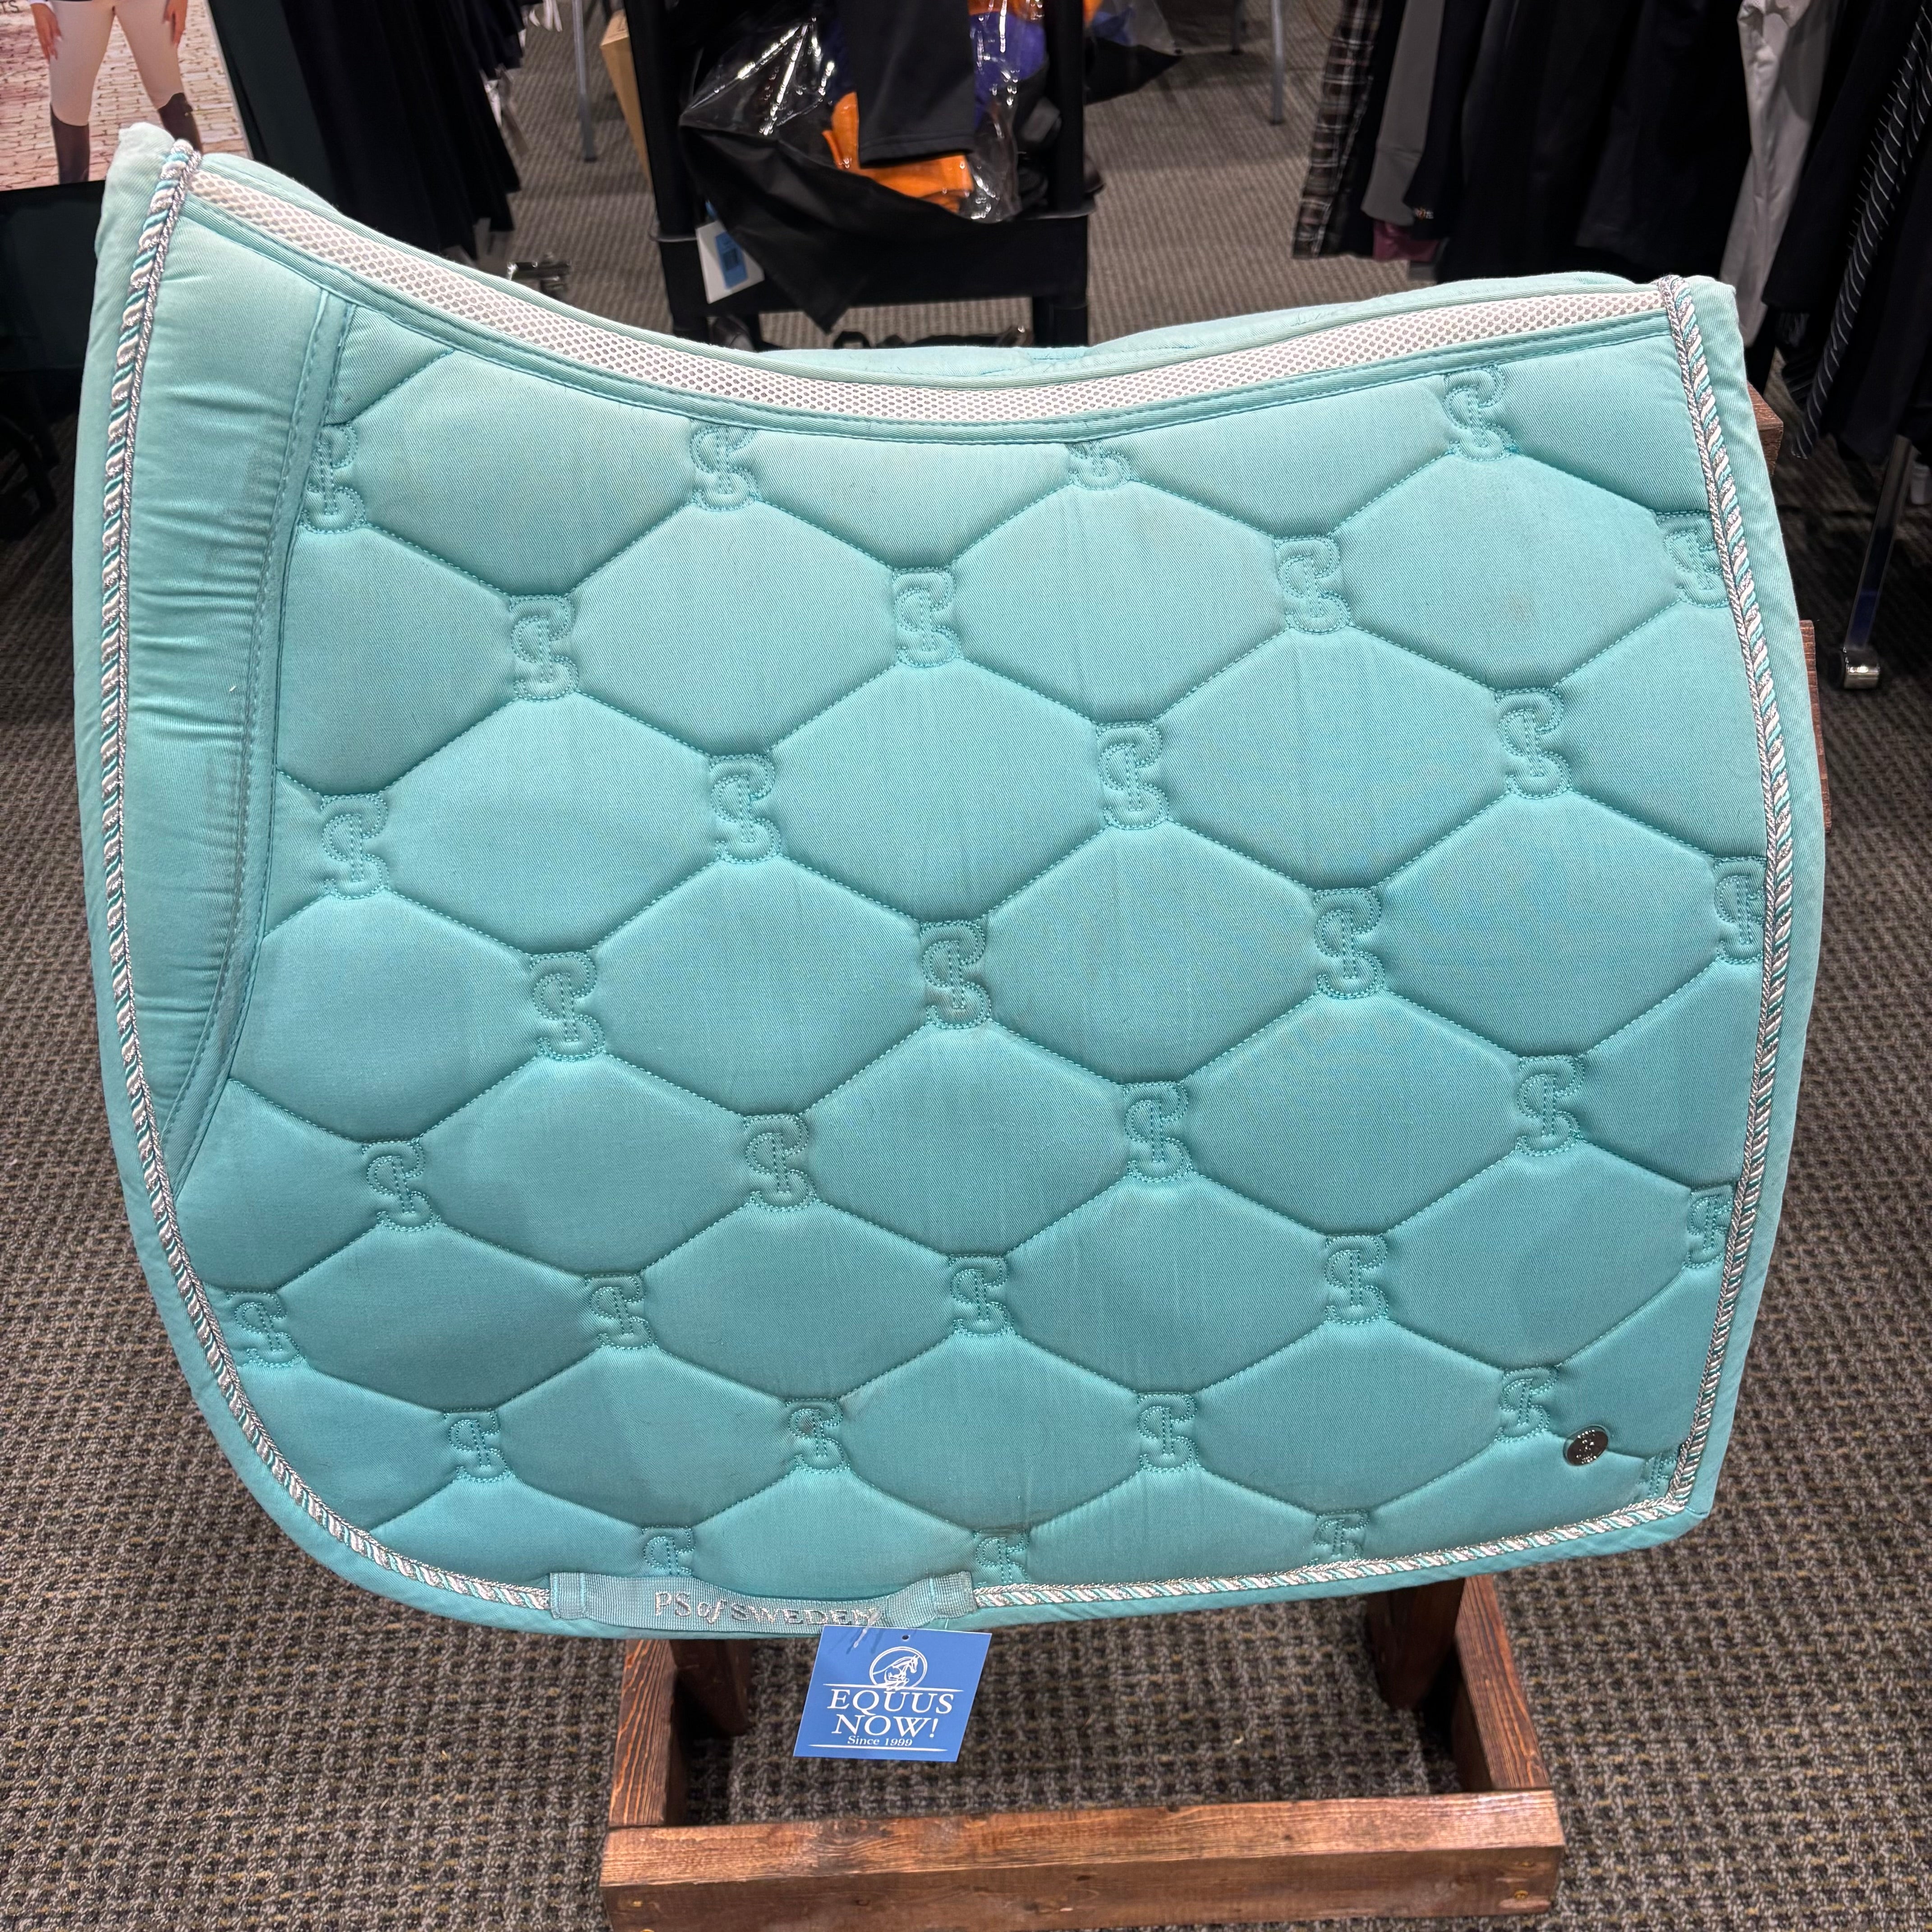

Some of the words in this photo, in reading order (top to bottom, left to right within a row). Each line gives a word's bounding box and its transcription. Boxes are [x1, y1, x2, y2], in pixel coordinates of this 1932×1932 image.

[654, 1591, 691, 1617] PS
[697, 1599, 727, 1624] of
[731, 1602, 877, 1625] SWEDEN
[827, 1688, 954, 1716] EQUUS
[831, 1714, 939, 1739] NOW!
[847, 1735, 880, 1746] Since
[884, 1737, 912, 1747] 1999
